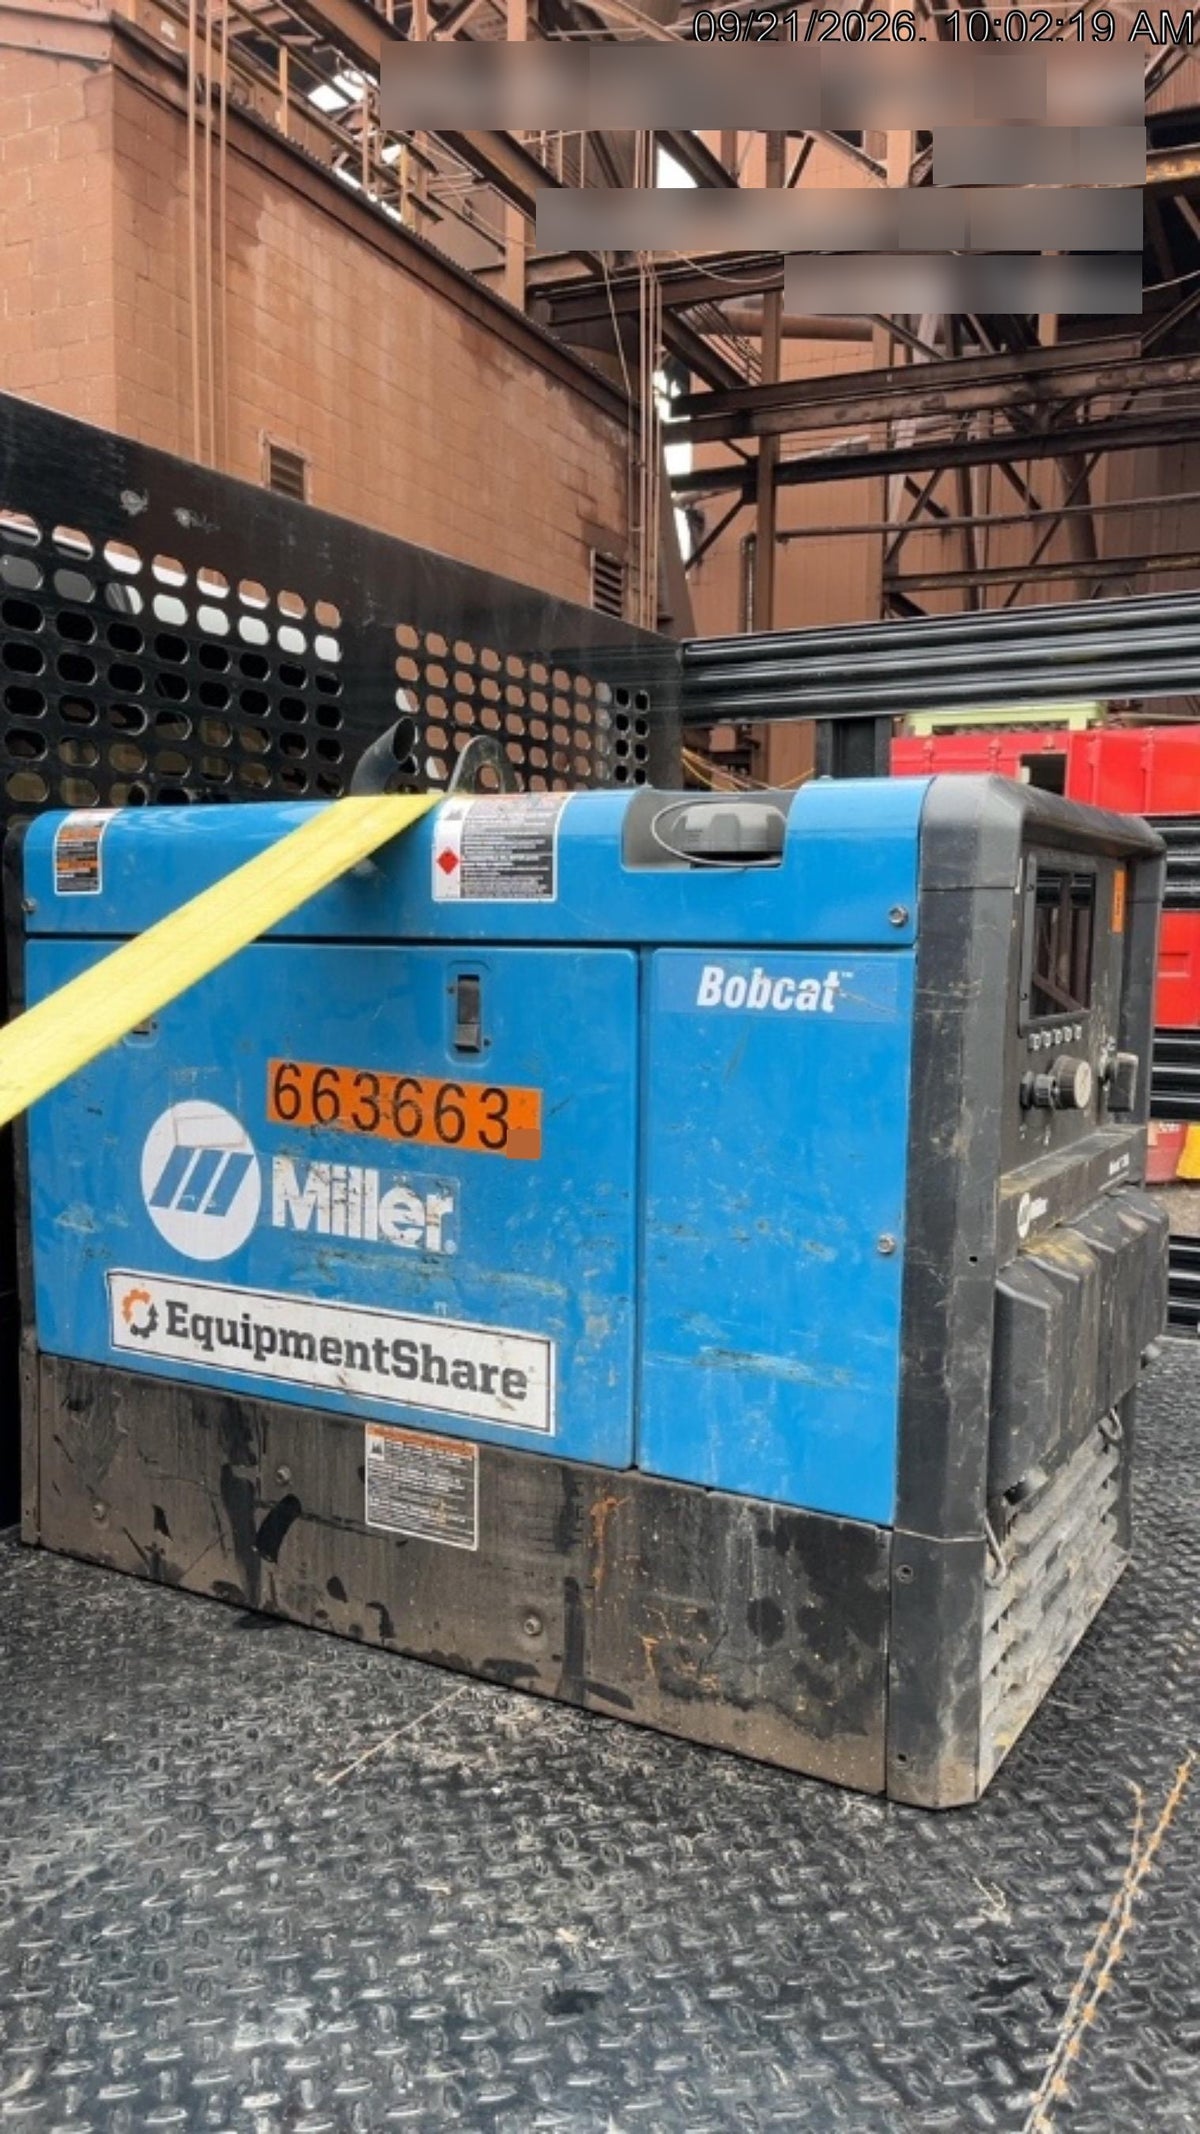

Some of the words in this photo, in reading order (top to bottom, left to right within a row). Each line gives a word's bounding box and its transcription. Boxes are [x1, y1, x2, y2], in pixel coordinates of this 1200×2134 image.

[697, 966, 840, 1013] Bobcat
[274, 1062, 509, 1150] 663663
[272, 1156, 453, 1252] Miller
[165, 1300, 528, 1400] EquipmentShare
